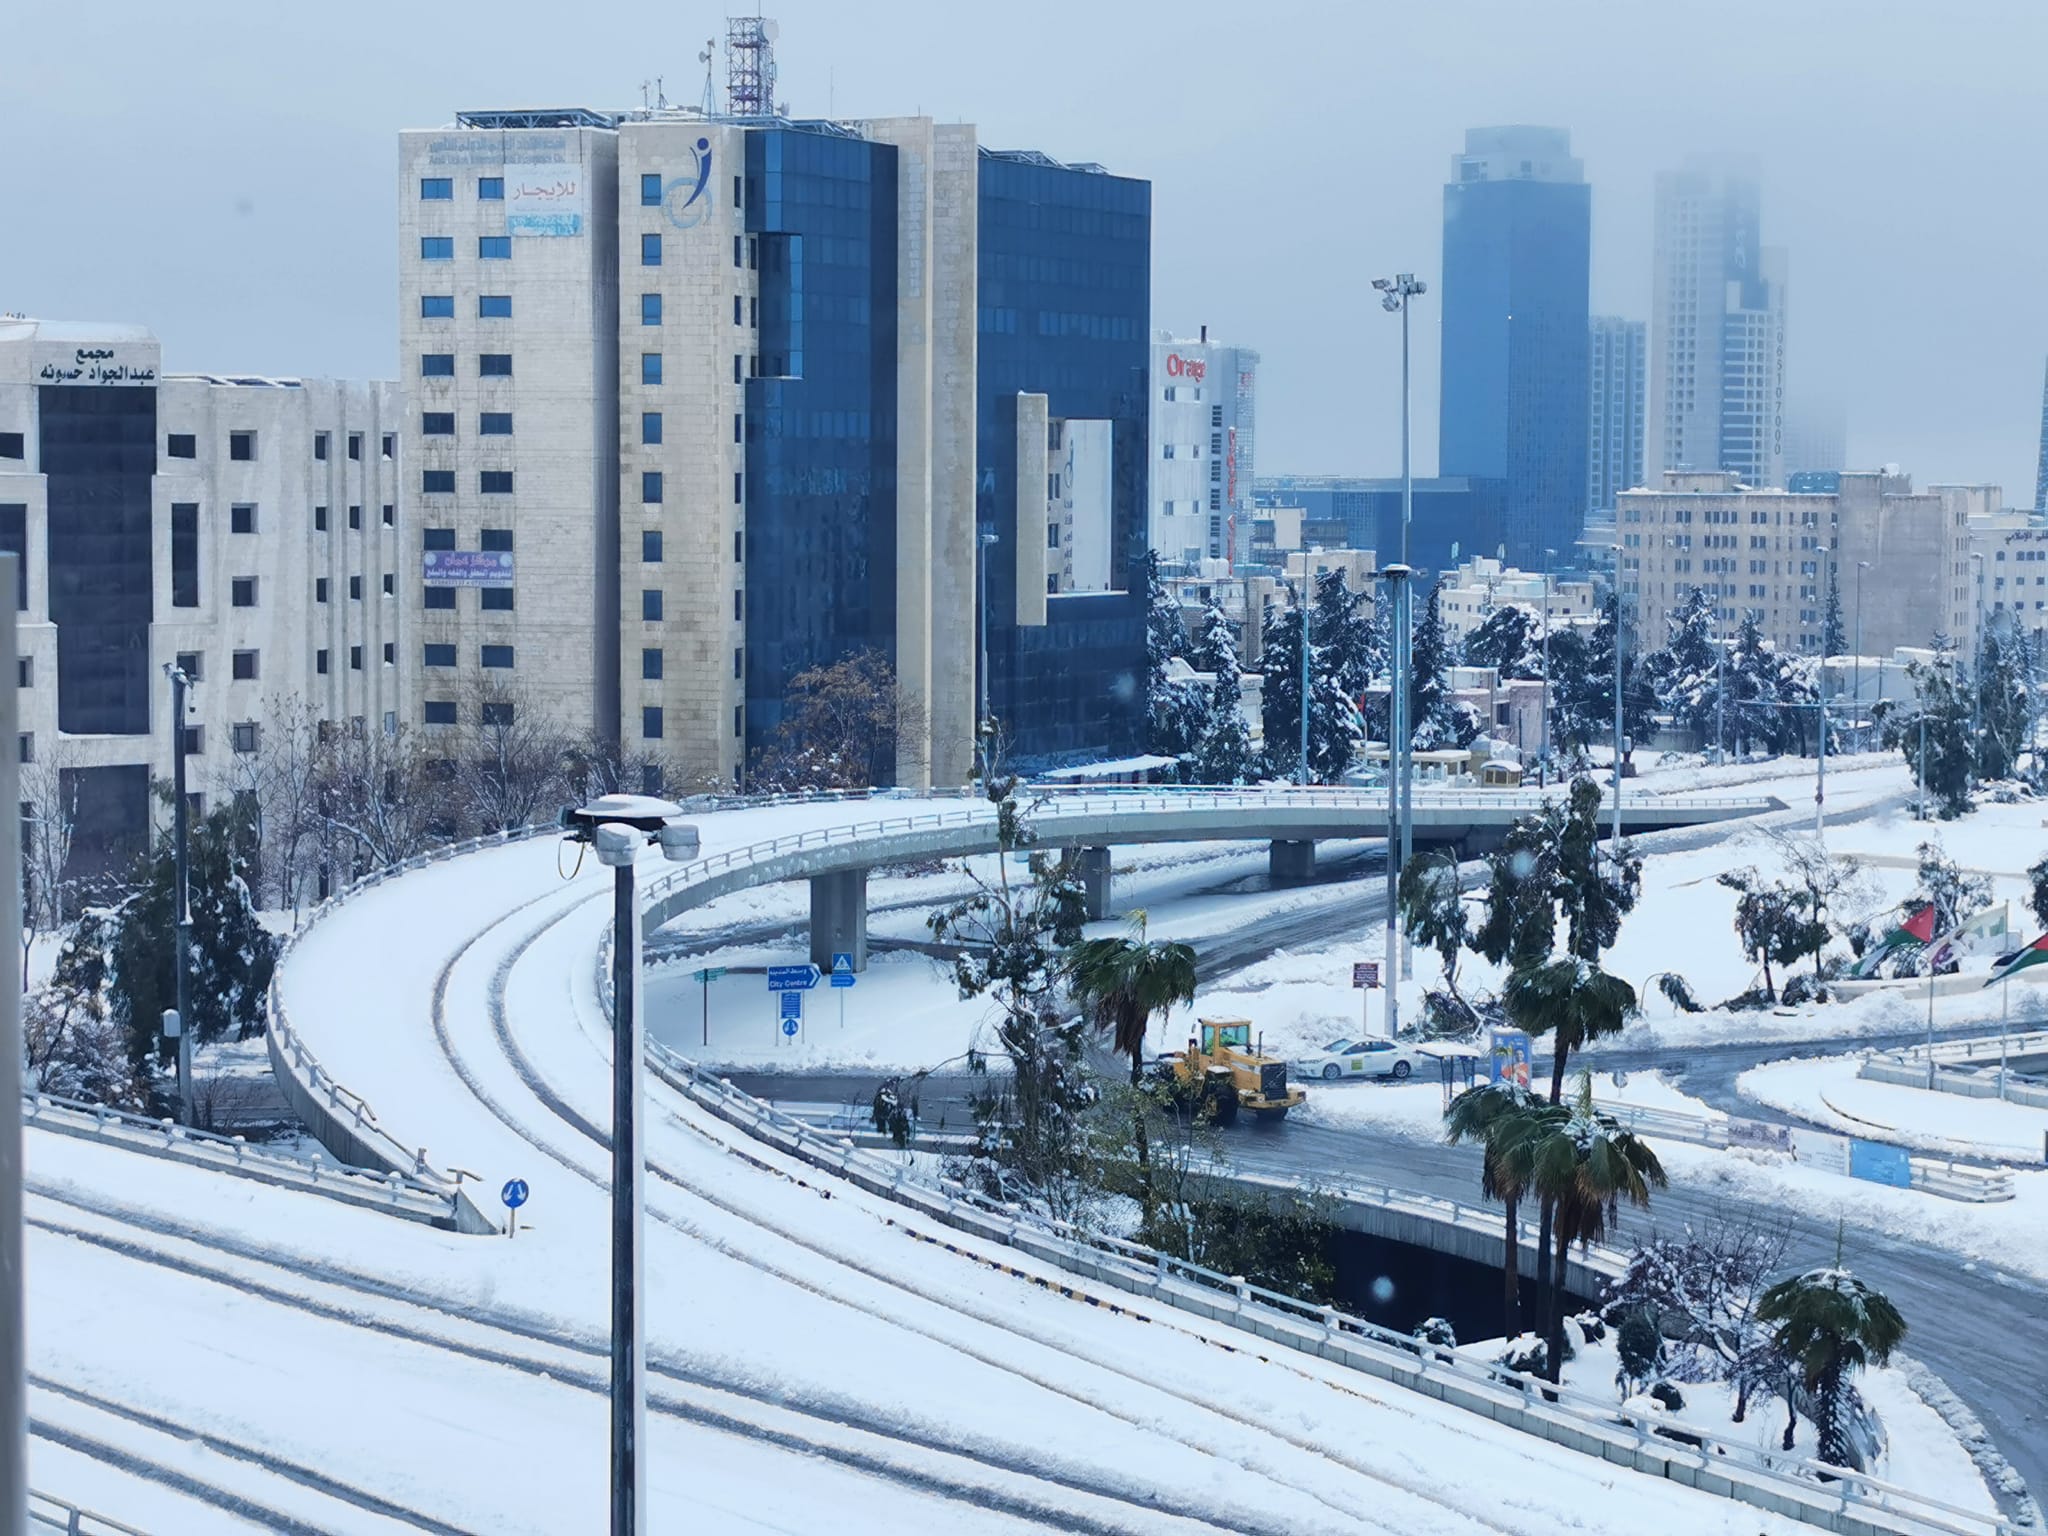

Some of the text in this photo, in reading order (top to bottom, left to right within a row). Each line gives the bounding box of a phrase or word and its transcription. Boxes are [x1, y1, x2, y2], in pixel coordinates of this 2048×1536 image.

[513, 181, 576, 201] للإيجار
[75, 348, 114, 364] مجمع
[769, 980, 807, 988] City Centre
